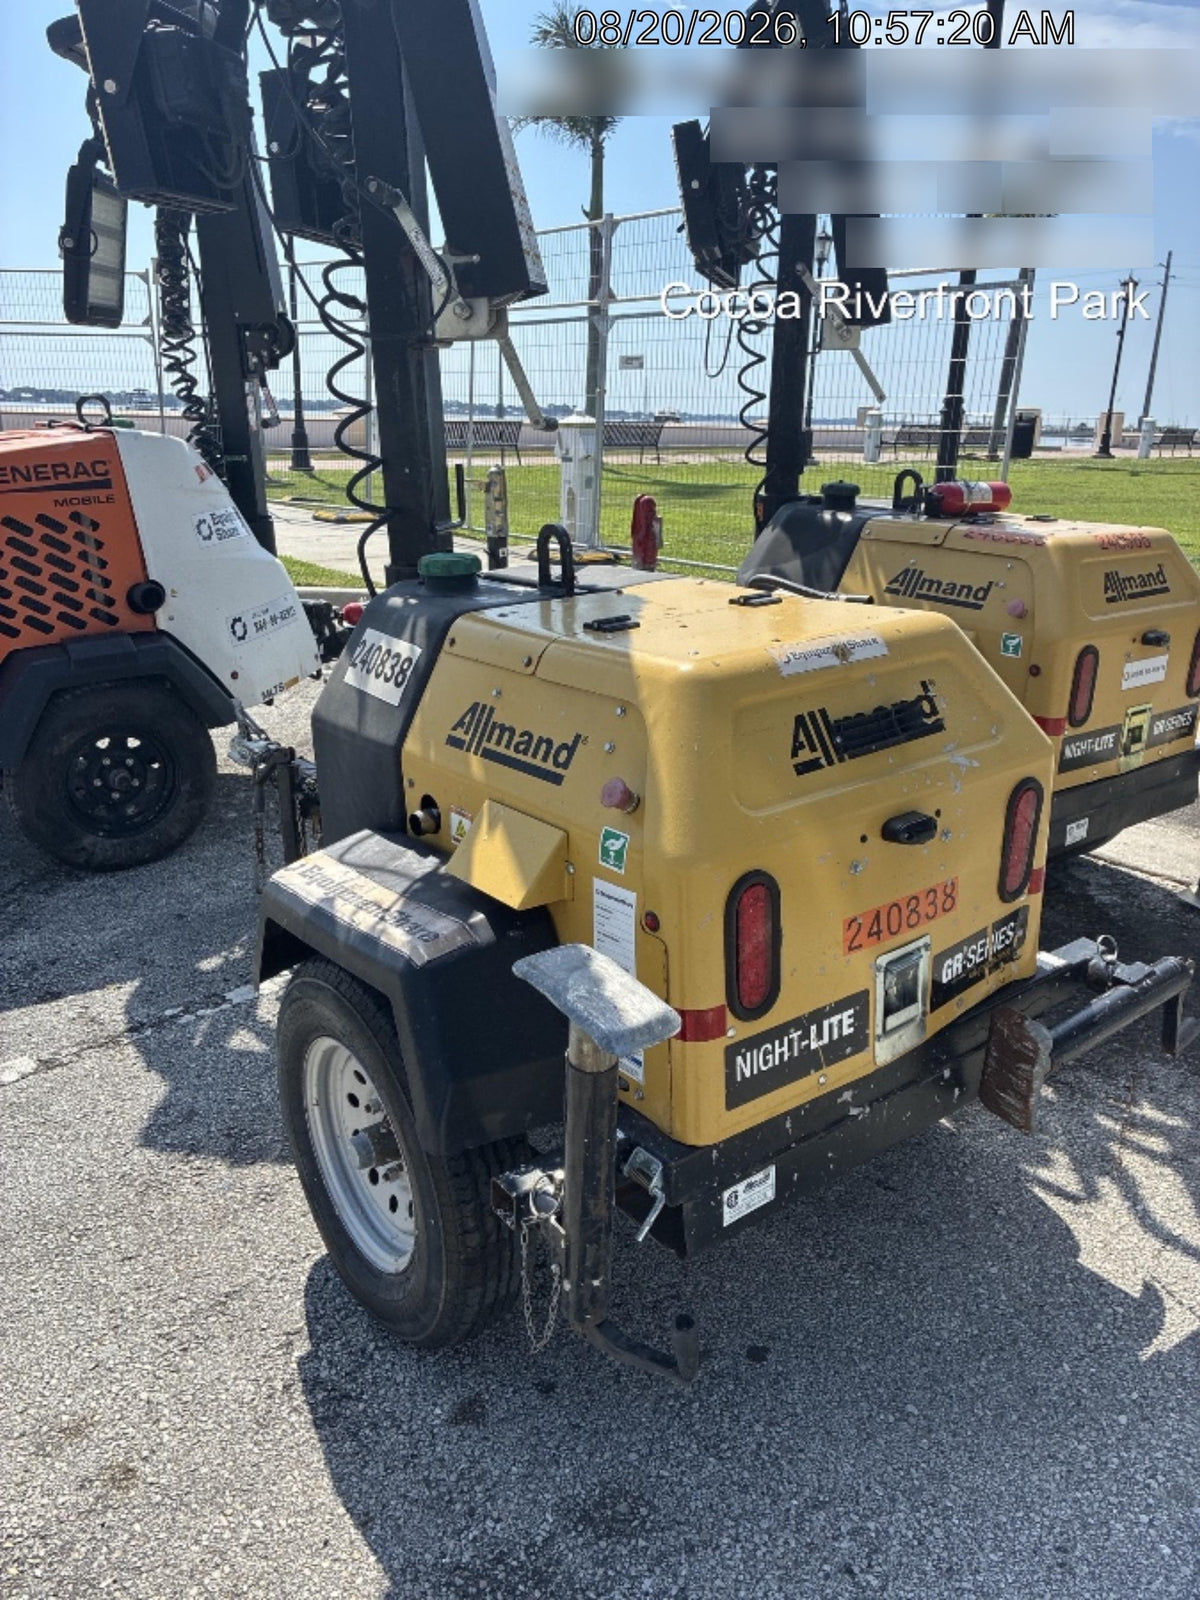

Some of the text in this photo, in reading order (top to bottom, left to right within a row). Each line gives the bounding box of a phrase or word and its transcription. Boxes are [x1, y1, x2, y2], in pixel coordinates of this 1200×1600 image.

[0, 460, 110, 484] ENERAC
[54, 494, 115, 507] MOBILE
[885, 568, 994, 606] Allmand
[1103, 564, 1169, 601] Allmand
[349, 639, 413, 688] 240838
[447, 702, 582, 776] Allmand
[846, 882, 957, 952] 240838
[736, 1009, 854, 1082] NIGHT-LITE
